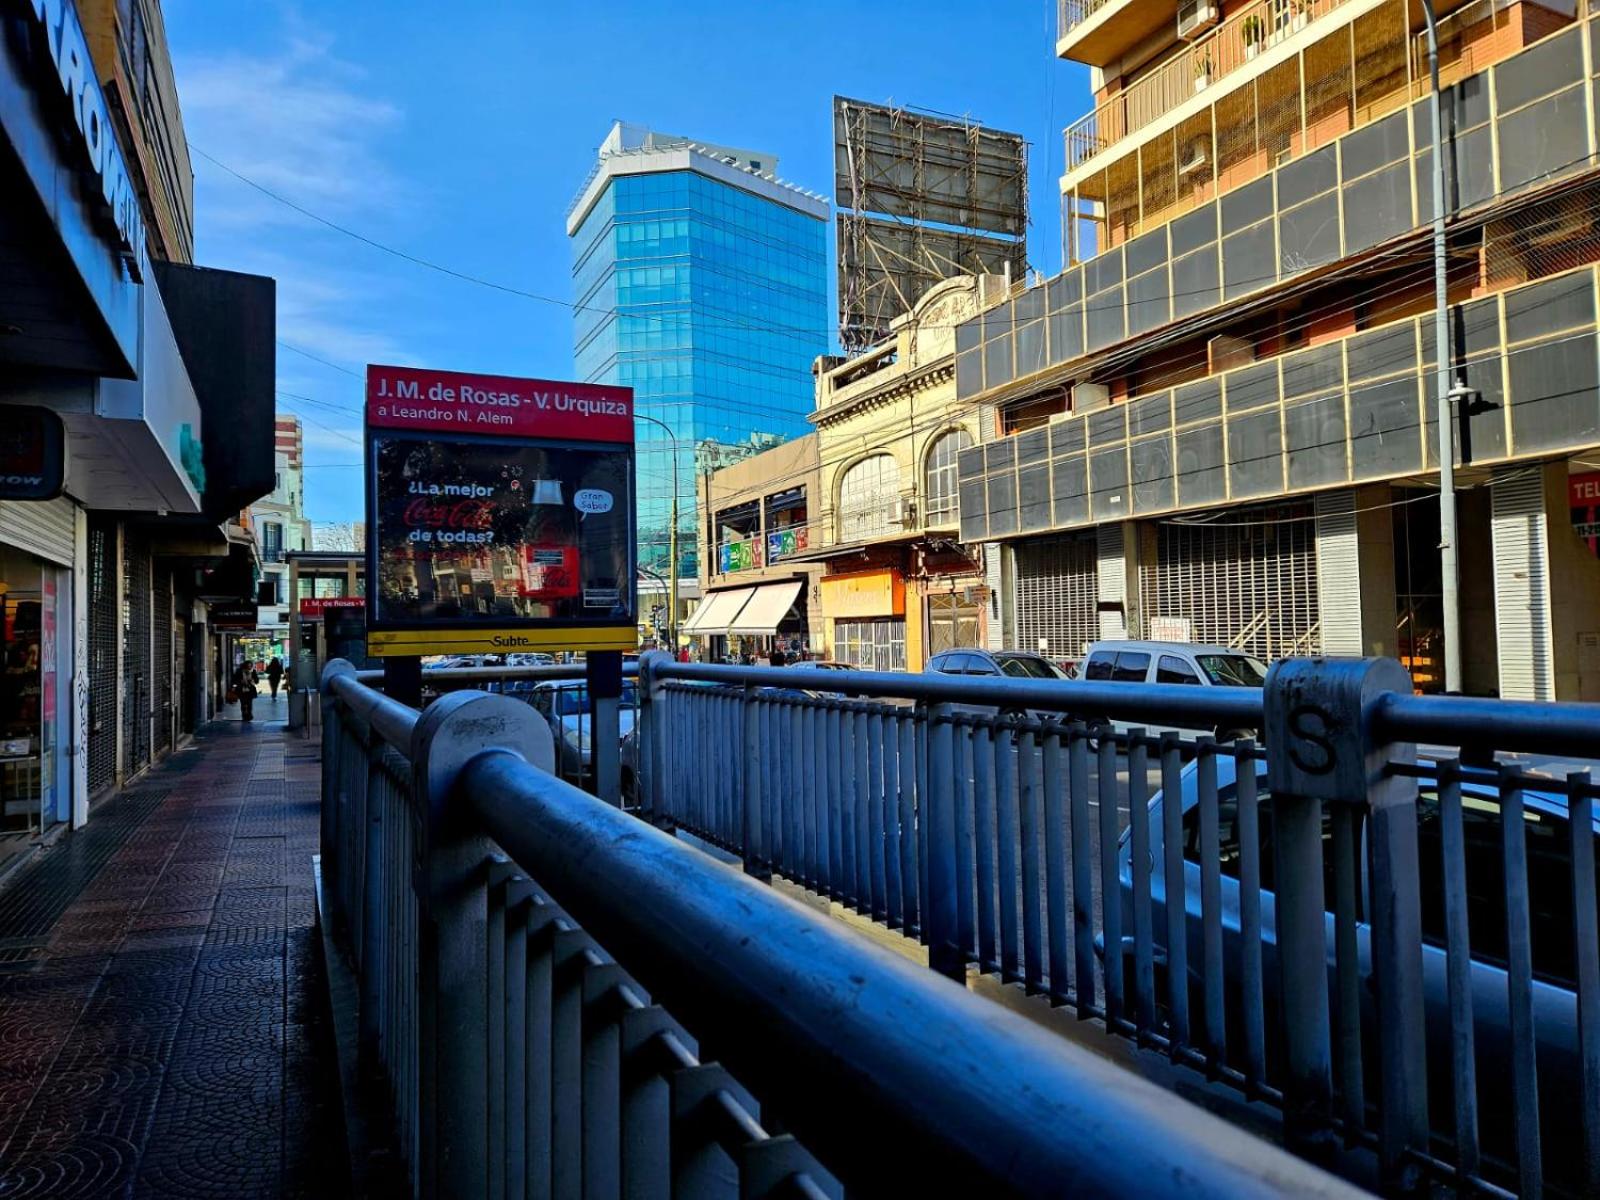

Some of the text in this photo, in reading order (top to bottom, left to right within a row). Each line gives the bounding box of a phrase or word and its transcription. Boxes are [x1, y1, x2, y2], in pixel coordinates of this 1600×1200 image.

[377, 378, 394, 398] J.
[396, 380, 425, 401] M.
[428, 382, 456, 402] de
[460, 386, 520, 407] Rosas
[533, 392, 551, 410] V.
[554, 393, 627, 417] Urquiza
[378, 405, 513, 425] a Leandro N. Alem
[408, 481, 495, 499] ¿La mejor
[409, 529, 495, 543] de todas?
[494, 635, 529, 647] Subte
